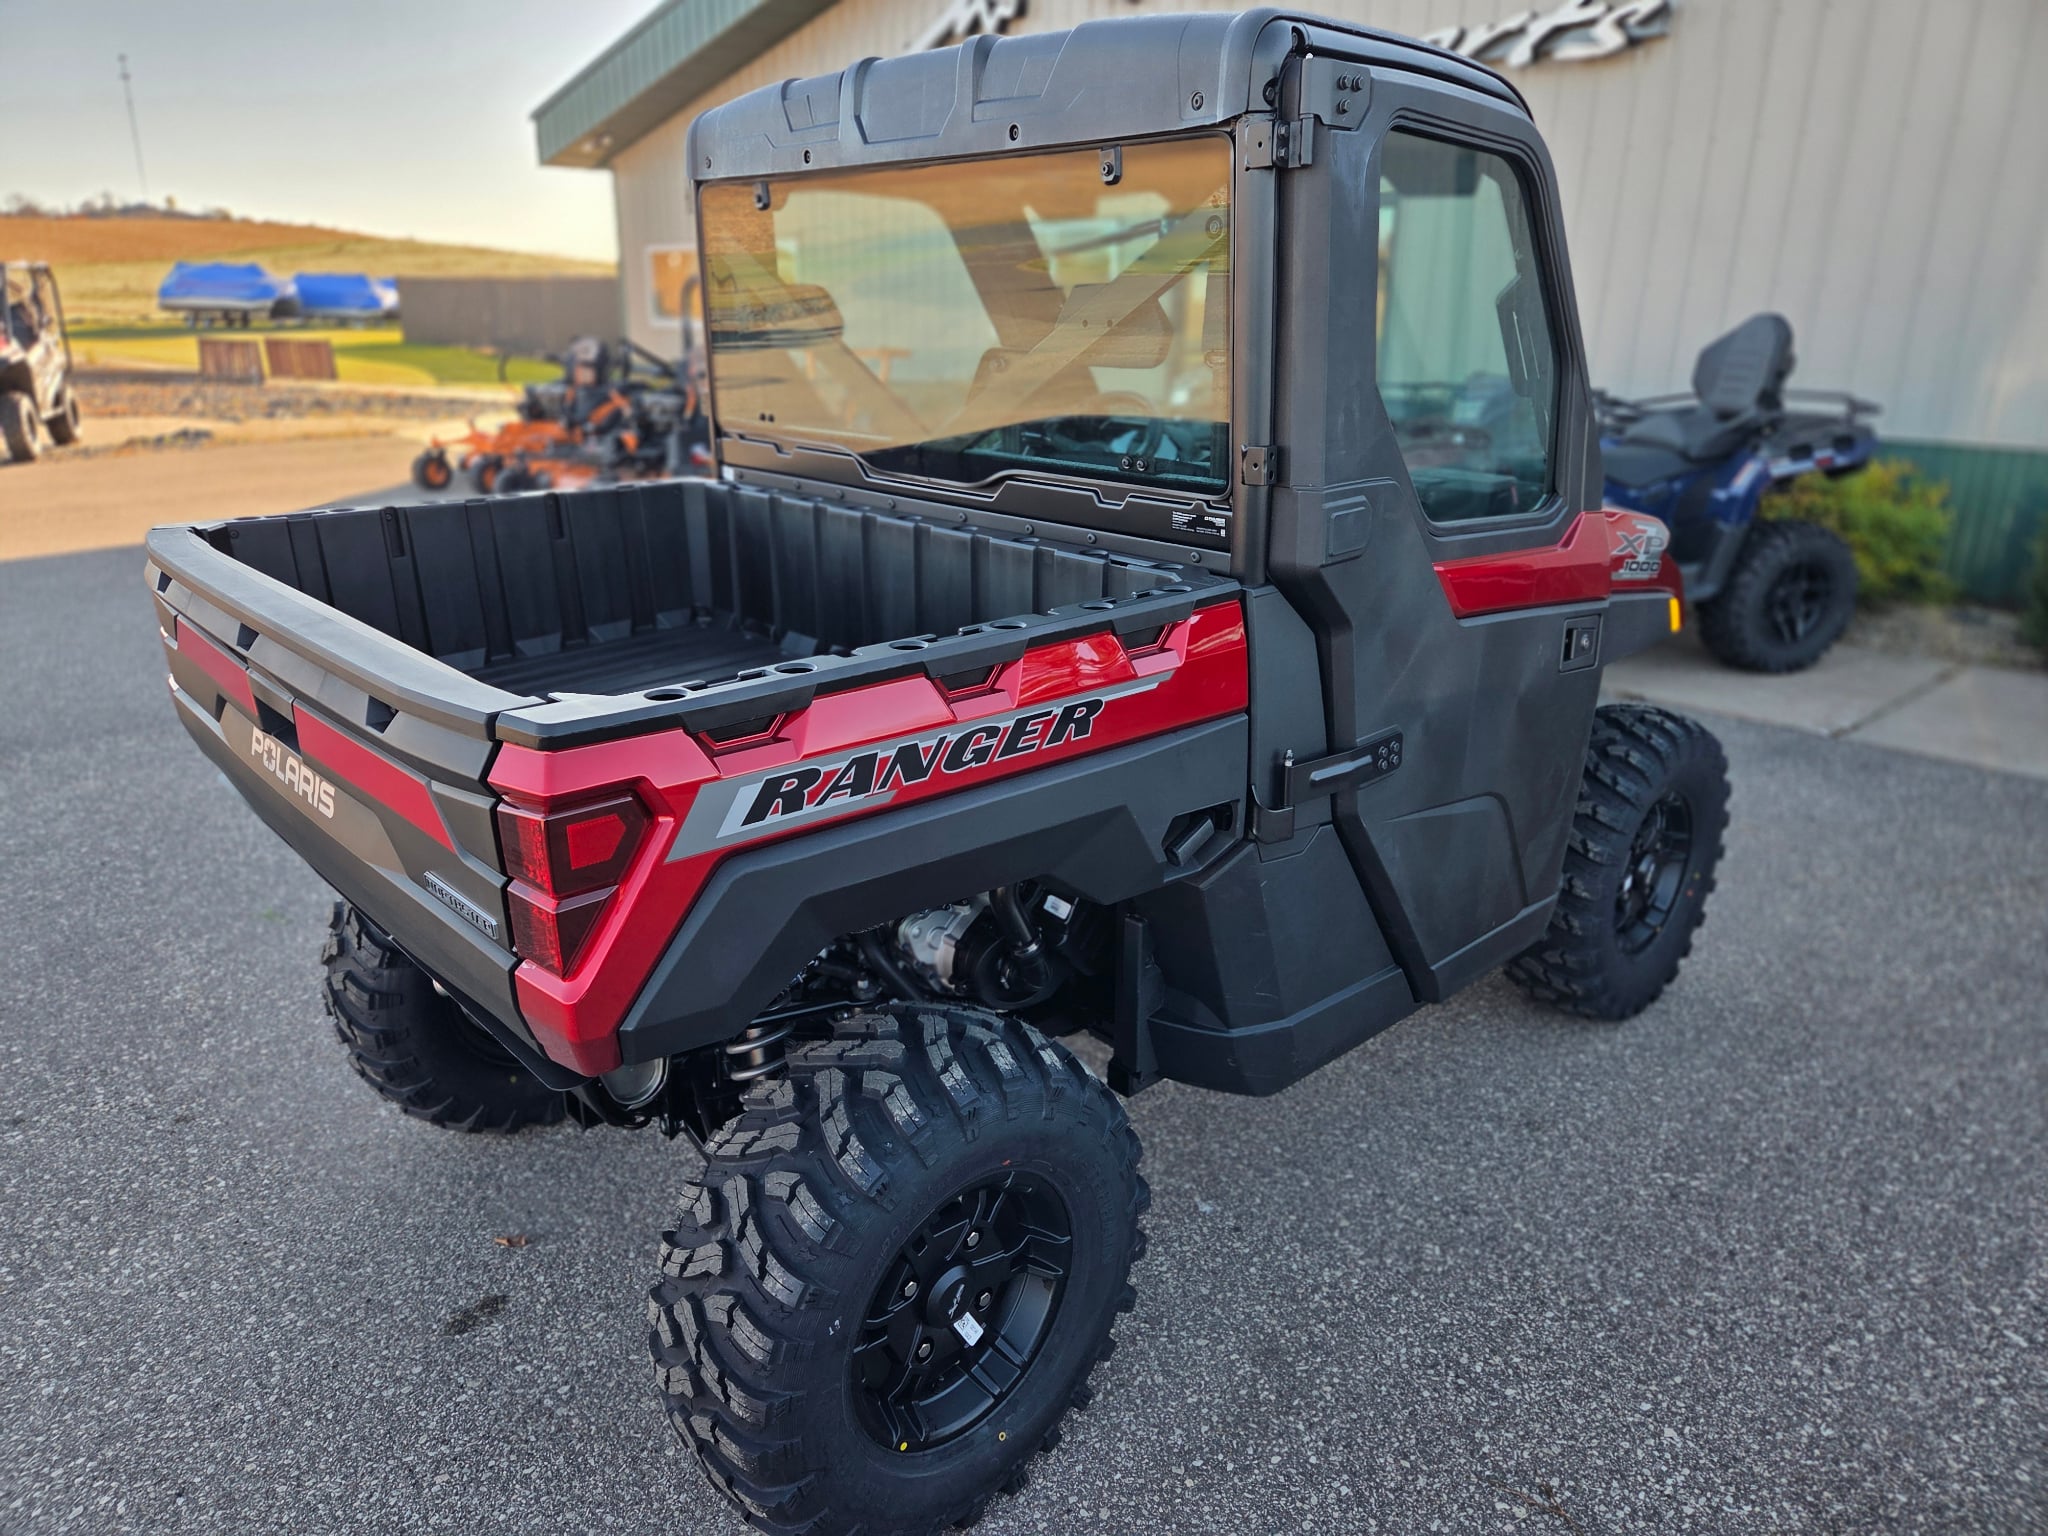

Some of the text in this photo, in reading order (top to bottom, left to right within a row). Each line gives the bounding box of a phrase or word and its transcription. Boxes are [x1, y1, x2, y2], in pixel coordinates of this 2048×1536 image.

[1612, 530, 1665, 556] XP
[1623, 560, 1661, 573] 1000
[251, 729, 336, 819] POLARIS
[740, 698, 1104, 827] RANGER
